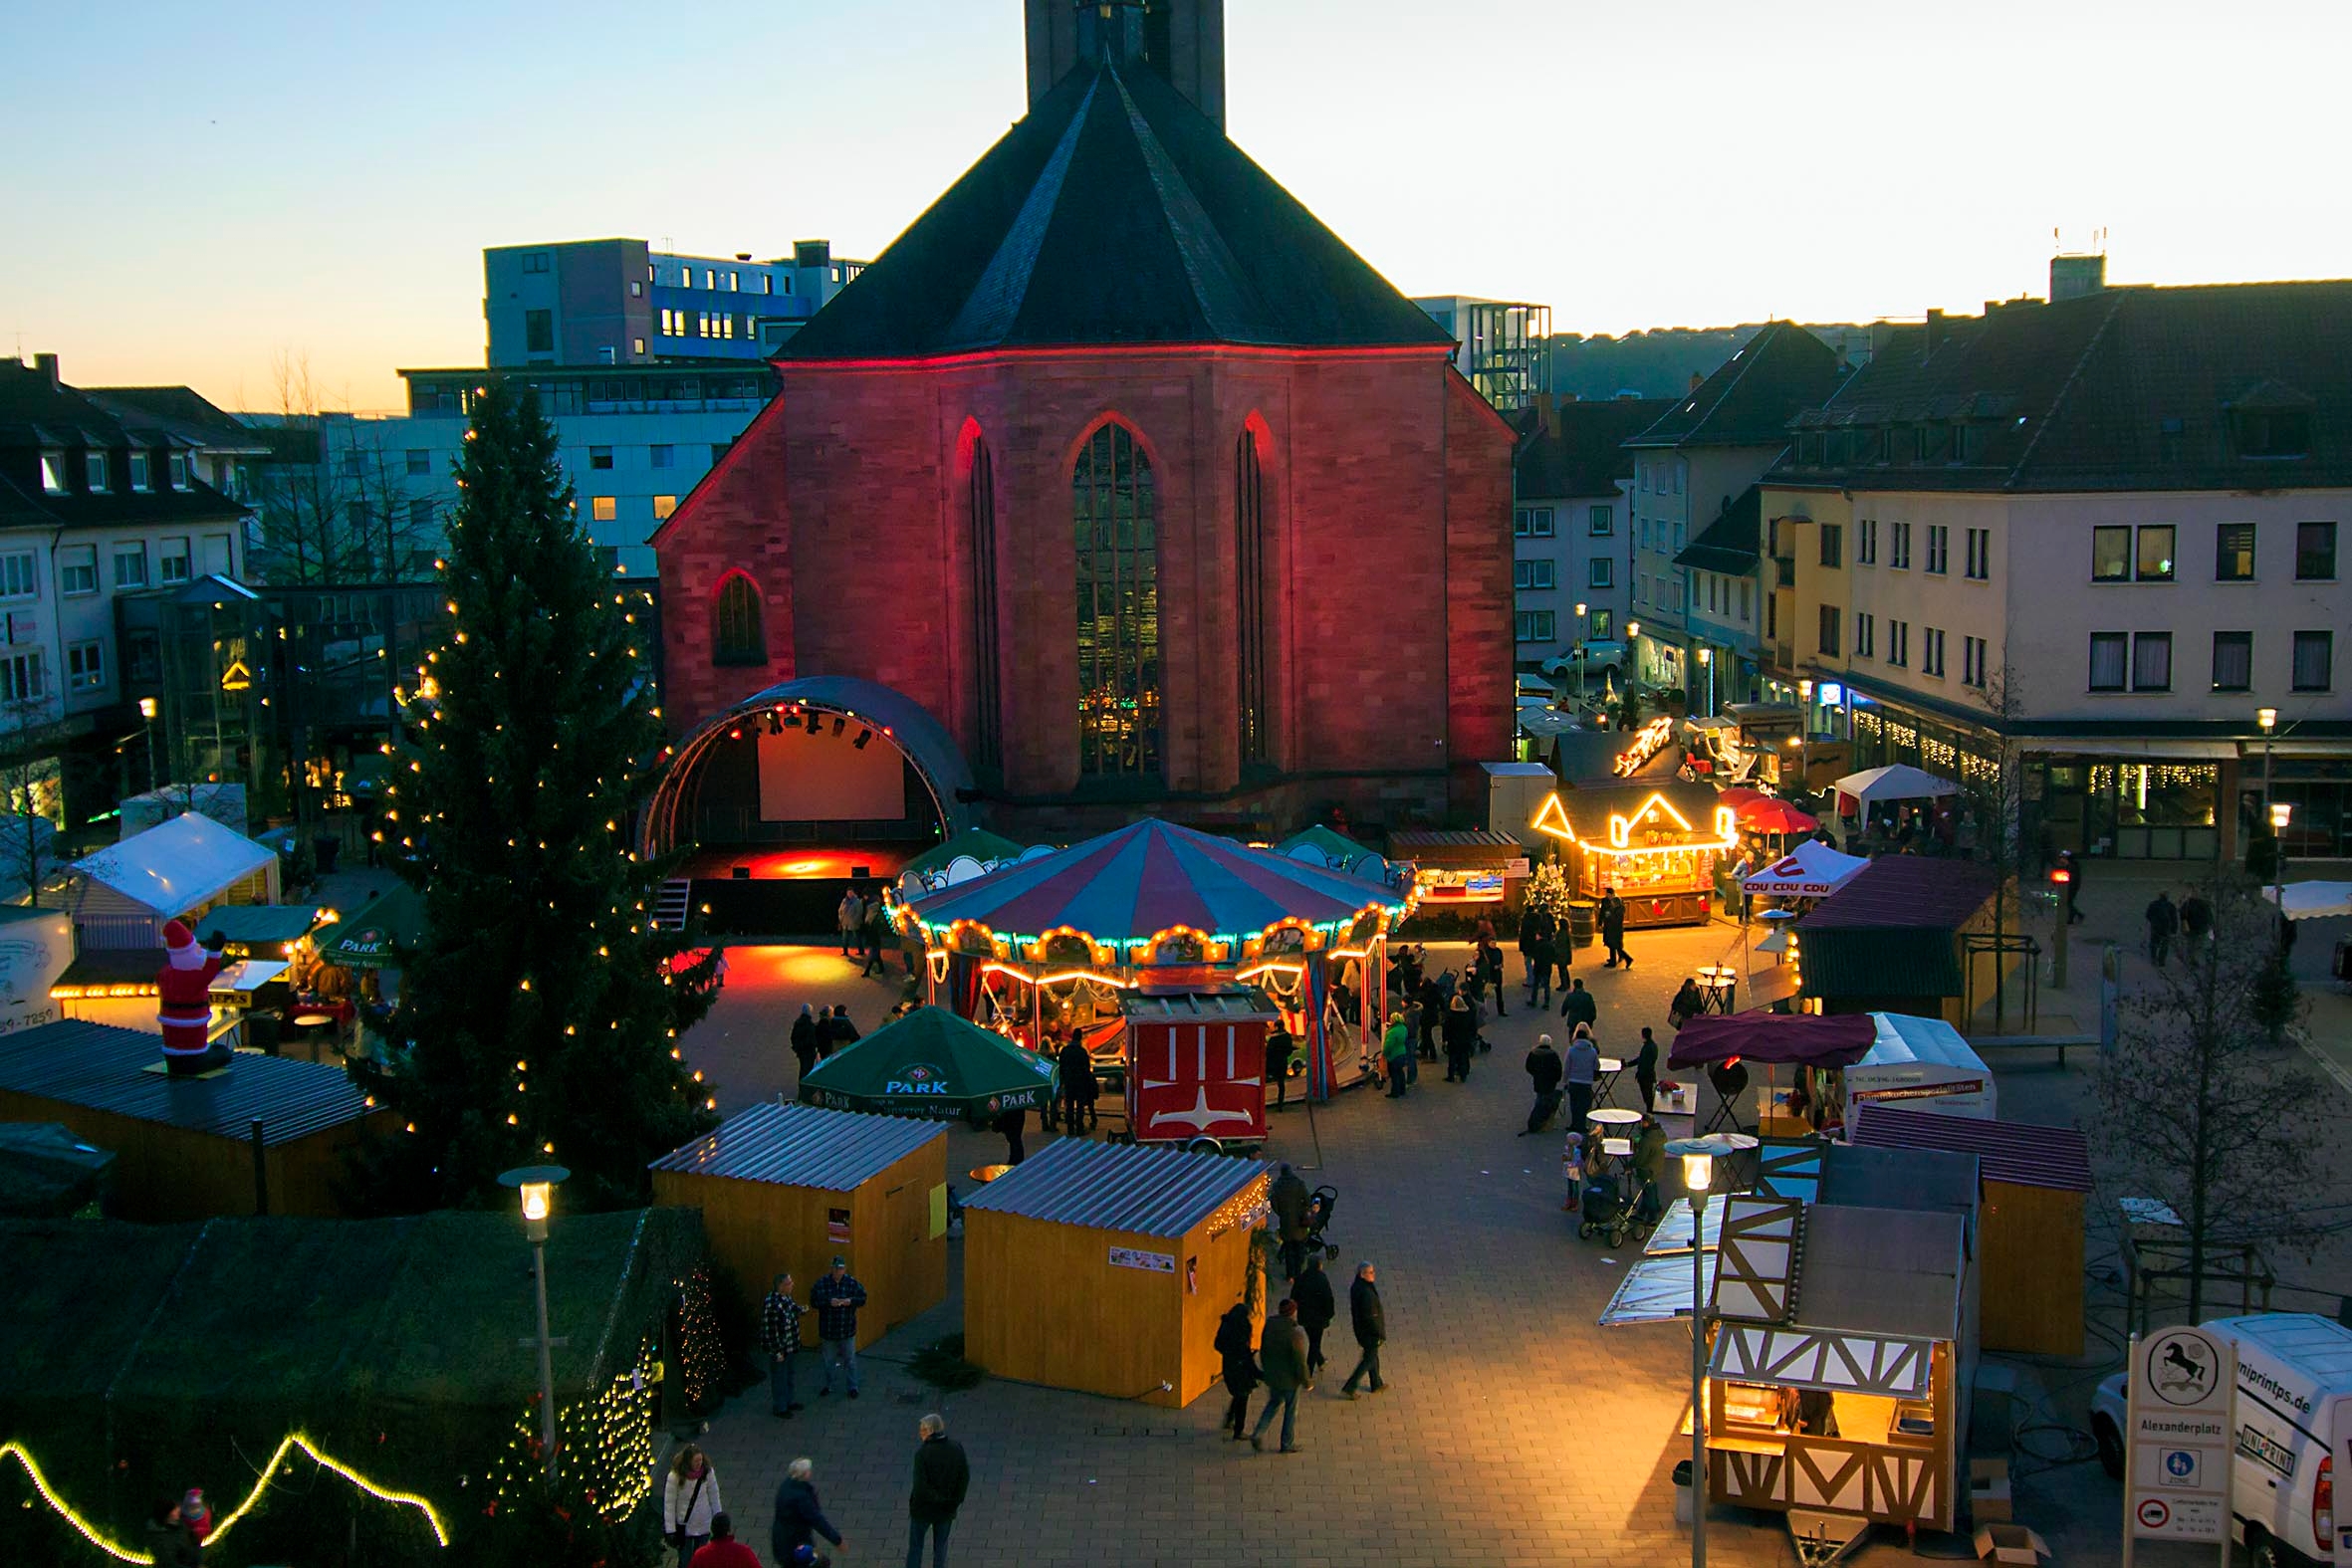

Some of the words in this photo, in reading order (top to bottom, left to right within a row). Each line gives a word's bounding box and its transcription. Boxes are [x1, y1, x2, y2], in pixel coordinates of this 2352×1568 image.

[1744, 882, 1768, 892] CDU
[1772, 883, 1798, 892] CDU
[1803, 884, 1829, 893] CDU
[339, 939, 382, 953] PARK
[885, 1081, 948, 1094] PARK
[1857, 1084, 1976, 1101] Flammkuchenspezialitäten
[824, 1094, 849, 1108] PARK
[1002, 1090, 1036, 1108] PARK
[929, 1105, 961, 1115] Natur
[2141, 1419, 2223, 1437] Alexanderplatz
